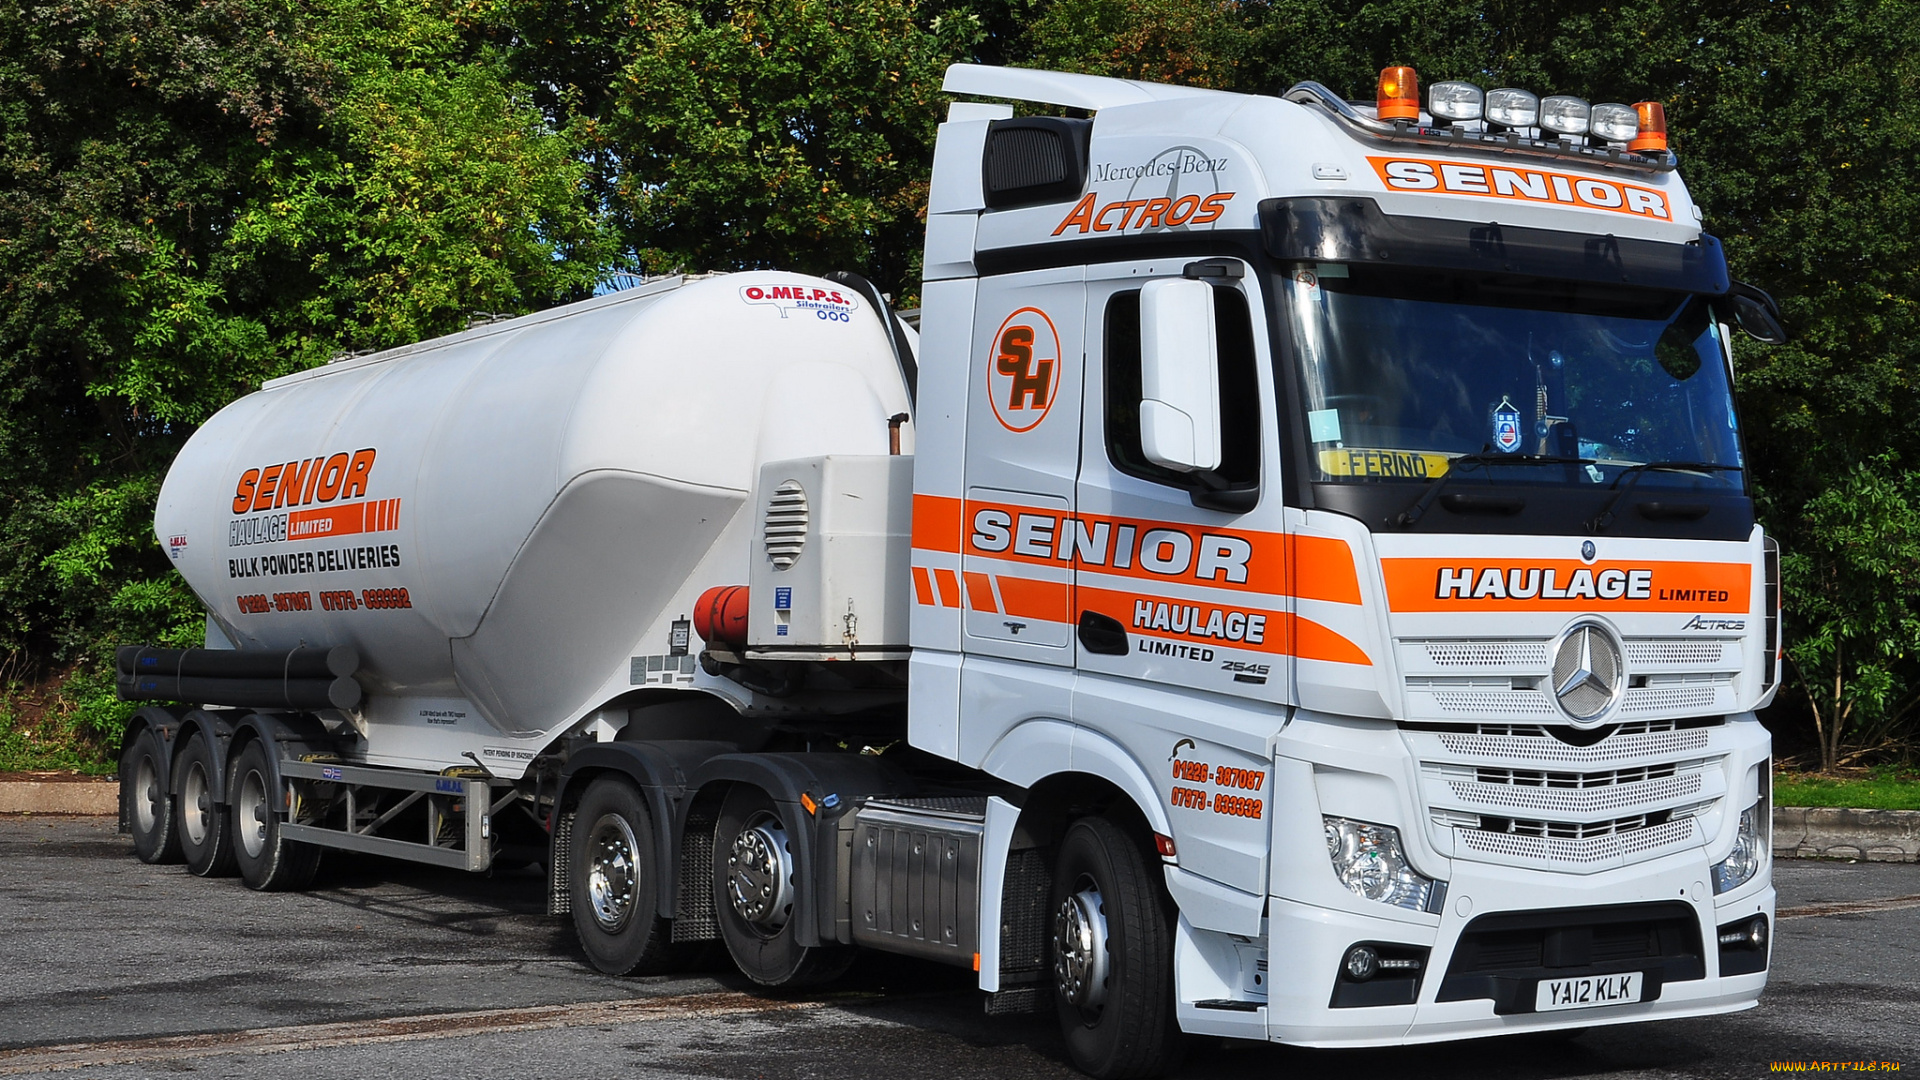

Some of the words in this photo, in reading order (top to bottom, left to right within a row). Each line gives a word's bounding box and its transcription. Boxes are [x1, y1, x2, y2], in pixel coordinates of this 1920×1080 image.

[1094, 154, 1228, 183] Mercedes-Benz
[1385, 161, 1669, 218] SENIOR
[232, 448, 376, 514] SENIOR
[228, 513, 288, 547] HAULAGE
[290, 517, 333, 536] LIMITED
[972, 509, 1252, 584] SENIOR
[228, 557, 260, 578] BULK
[261, 551, 315, 576] POWDER
[317, 544, 401, 572] DELIVERIES
[1436, 568, 1653, 600] HAULAGE
[1659, 588, 1729, 602] LIMITED
[1132, 598, 1267, 644] HAULAGE
[1138, 639, 1215, 664] LIMITED
[1221, 660, 1271, 675] 2545
[1172, 759, 1209, 783] 01226
[1215, 766, 1265, 791] 387087
[1171, 786, 1207, 811] 07973
[1213, 793, 1263, 819] 833332
[1595, 975, 1631, 1002] KLK
